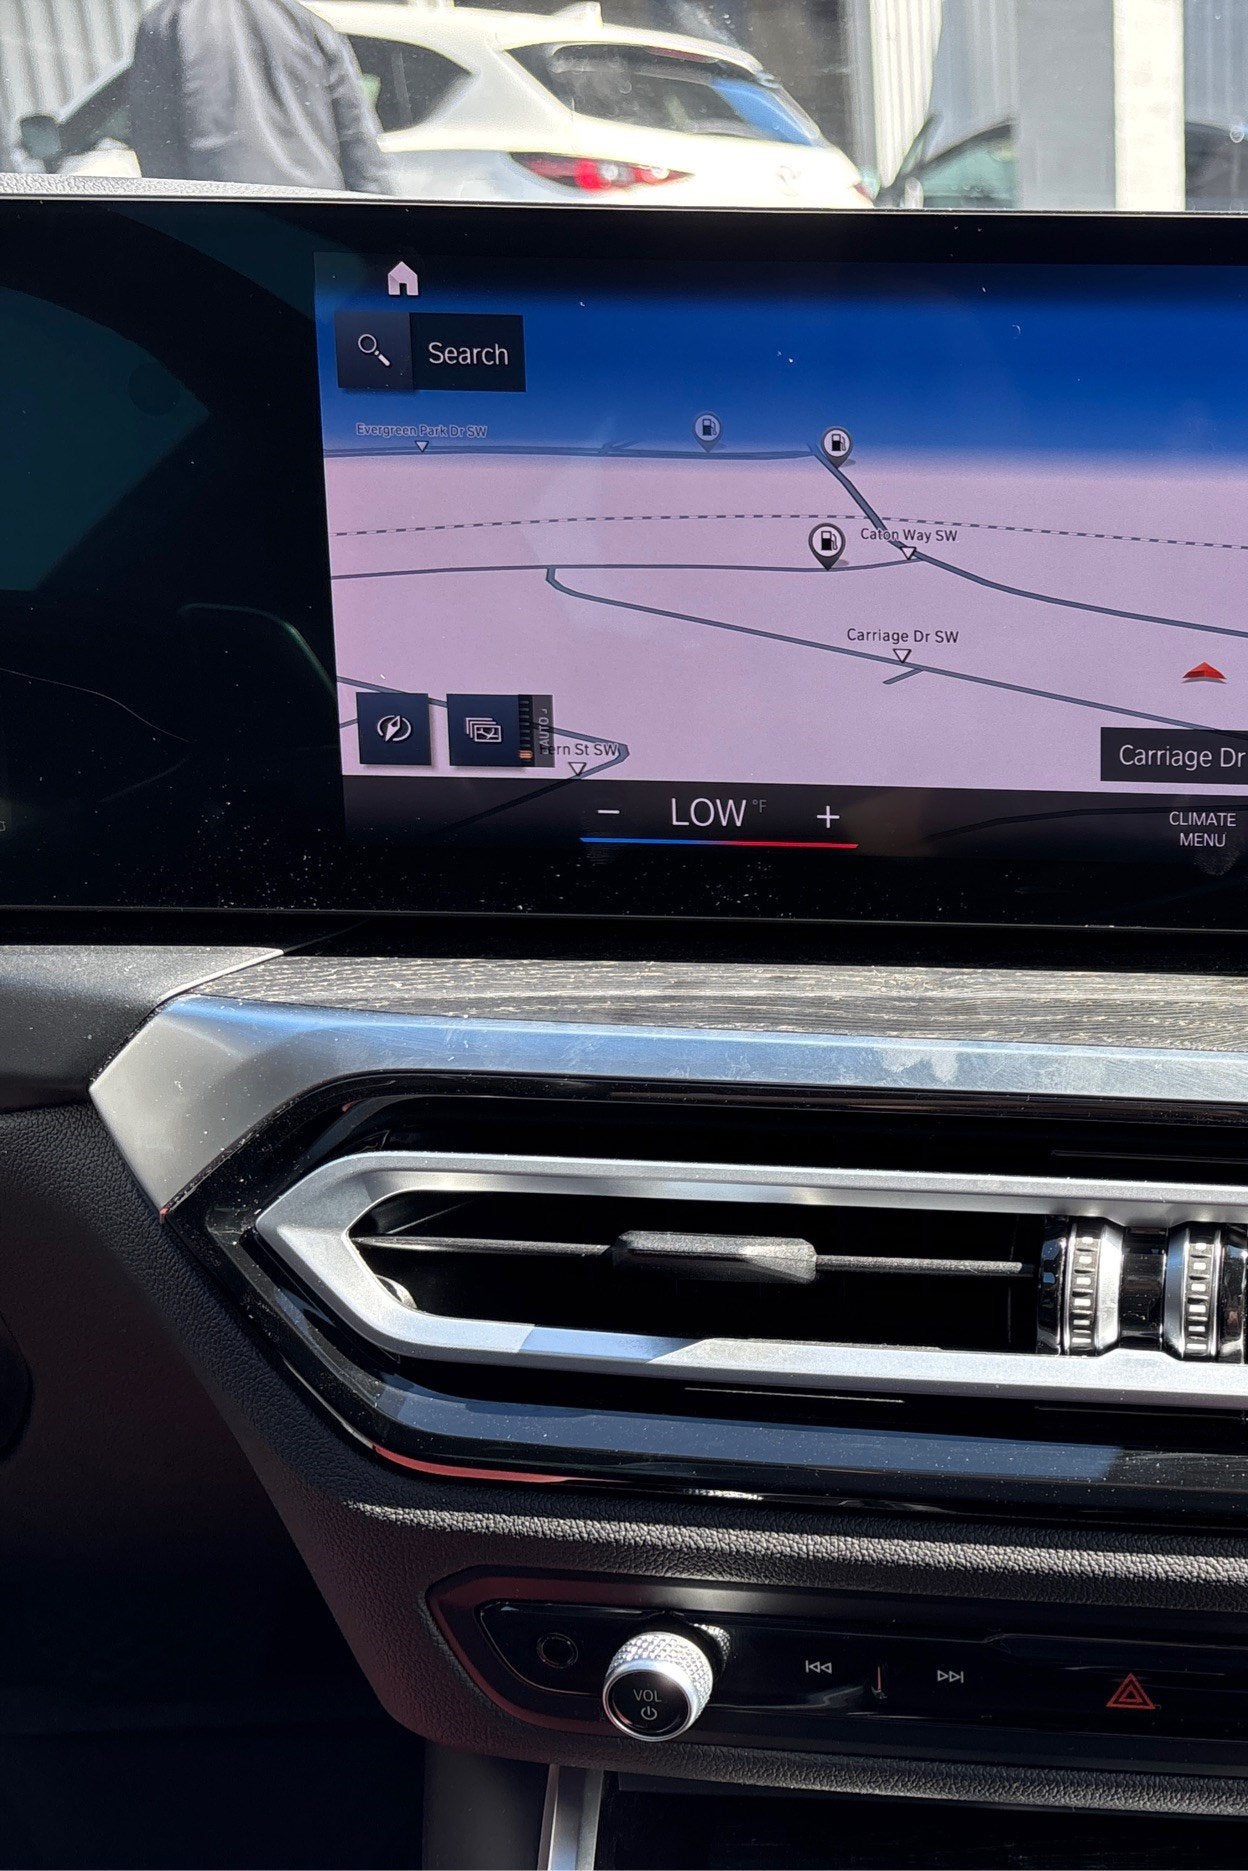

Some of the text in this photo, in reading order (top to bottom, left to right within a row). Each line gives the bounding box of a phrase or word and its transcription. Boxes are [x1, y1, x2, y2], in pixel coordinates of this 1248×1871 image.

[428, 341, 509, 366] Search
[356, 423, 487, 438] Evergreen Park Dr SW
[860, 527, 958, 544] Caton Way SW
[846, 627, 960, 645] Carriage Dr SW
[538, 716, 550, 748] AUTO
[574, 742, 590, 756] St
[593, 743, 618, 757] SW
[1119, 744, 1213, 771] Carriage
[1220, 747, 1246, 768] Dr
[671, 797, 747, 827] LOW
[1169, 811, 1237, 827] CLIMATE
[1179, 832, 1227, 848] MENU
[632, 1688, 662, 1703] VOL
